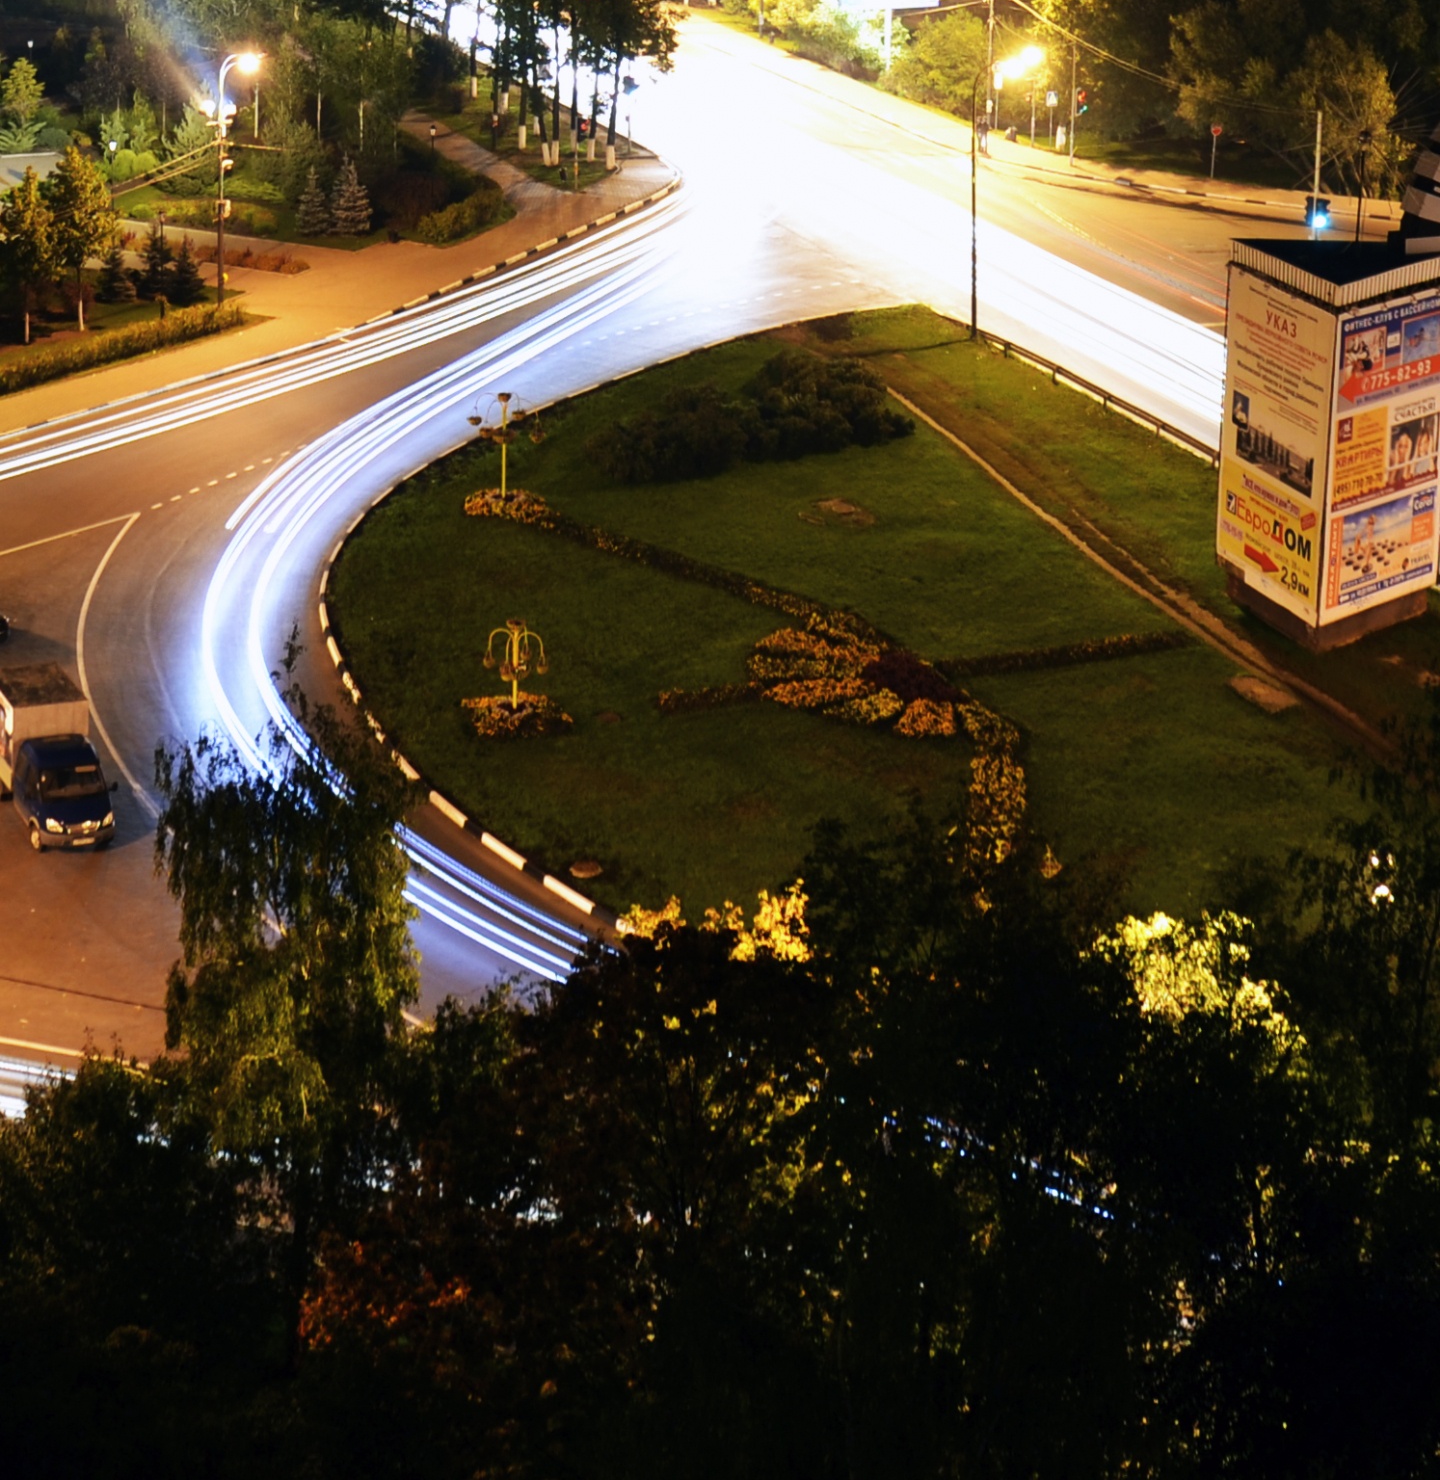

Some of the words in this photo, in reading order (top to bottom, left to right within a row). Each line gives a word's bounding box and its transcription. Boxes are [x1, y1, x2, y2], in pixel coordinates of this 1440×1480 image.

[1266, 310, 1297, 339] УКАЗ
[1344, 312, 1392, 332] ФИТНЕС-КЛУБ
[1393, 309, 1399, 319] С
[1370, 359, 1431, 390] 775-82-93
[1336, 445, 1383, 469] КВАРТИРЫ
[1414, 497, 1432, 510] Coral
